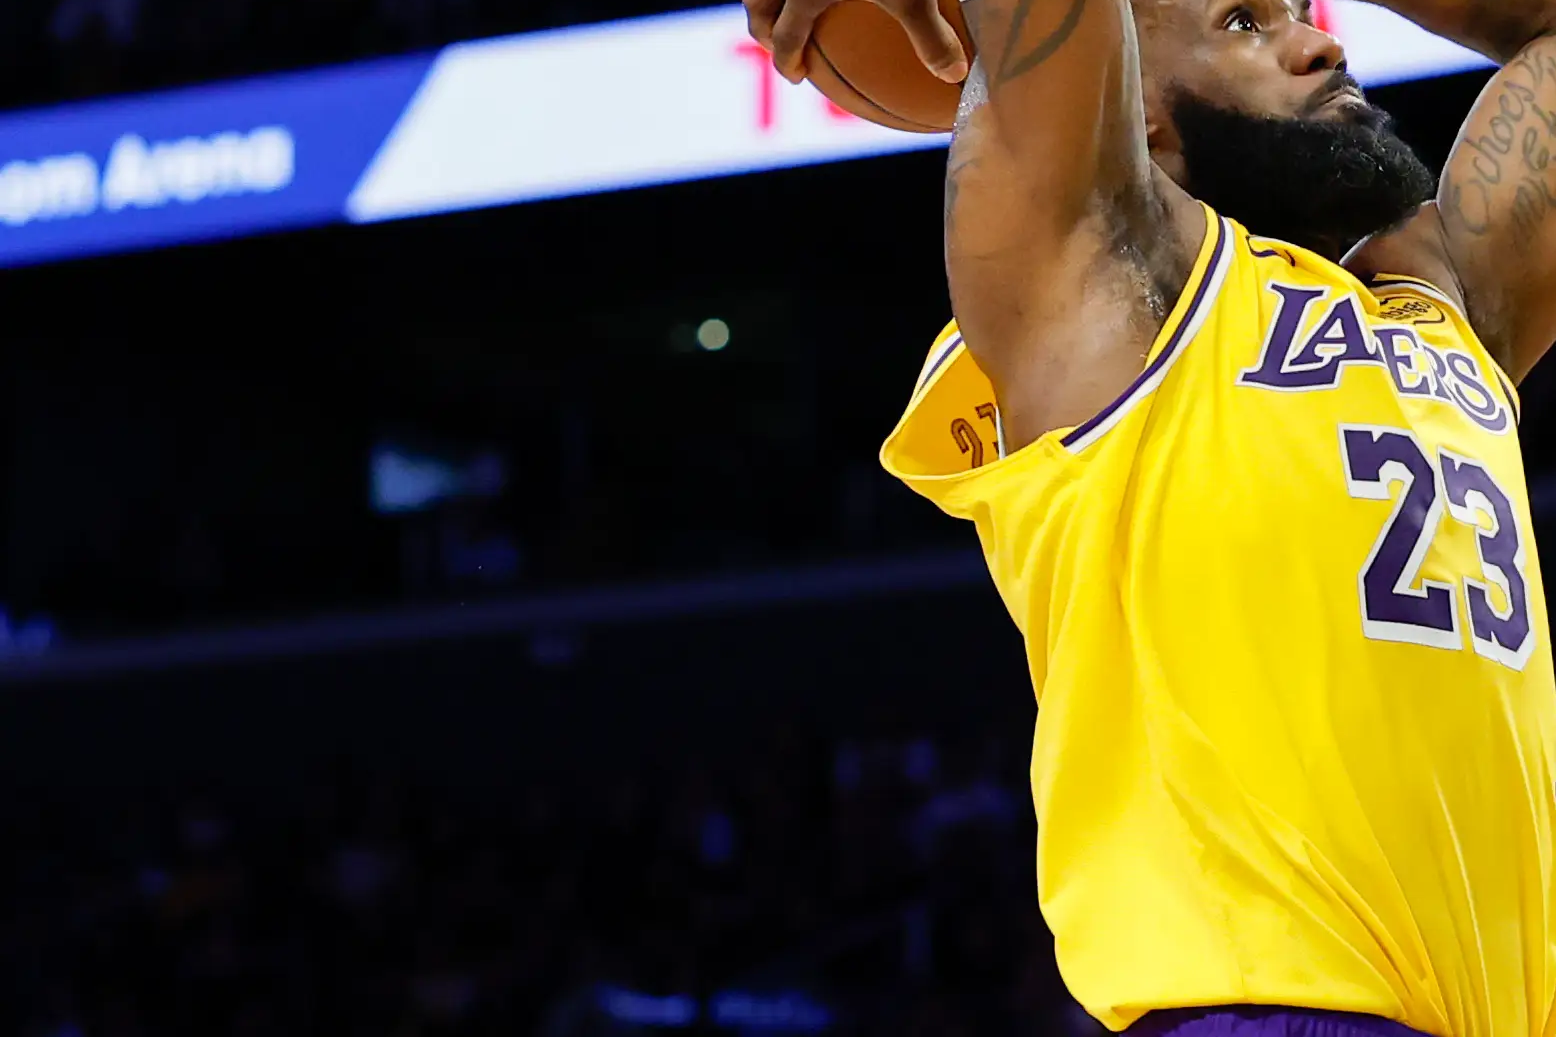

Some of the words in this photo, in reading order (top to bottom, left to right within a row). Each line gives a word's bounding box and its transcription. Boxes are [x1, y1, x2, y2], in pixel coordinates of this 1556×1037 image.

[102, 125, 295, 212] Arena
[1235, 279, 1511, 436] LAERS
[1337, 422, 1536, 672] 23
